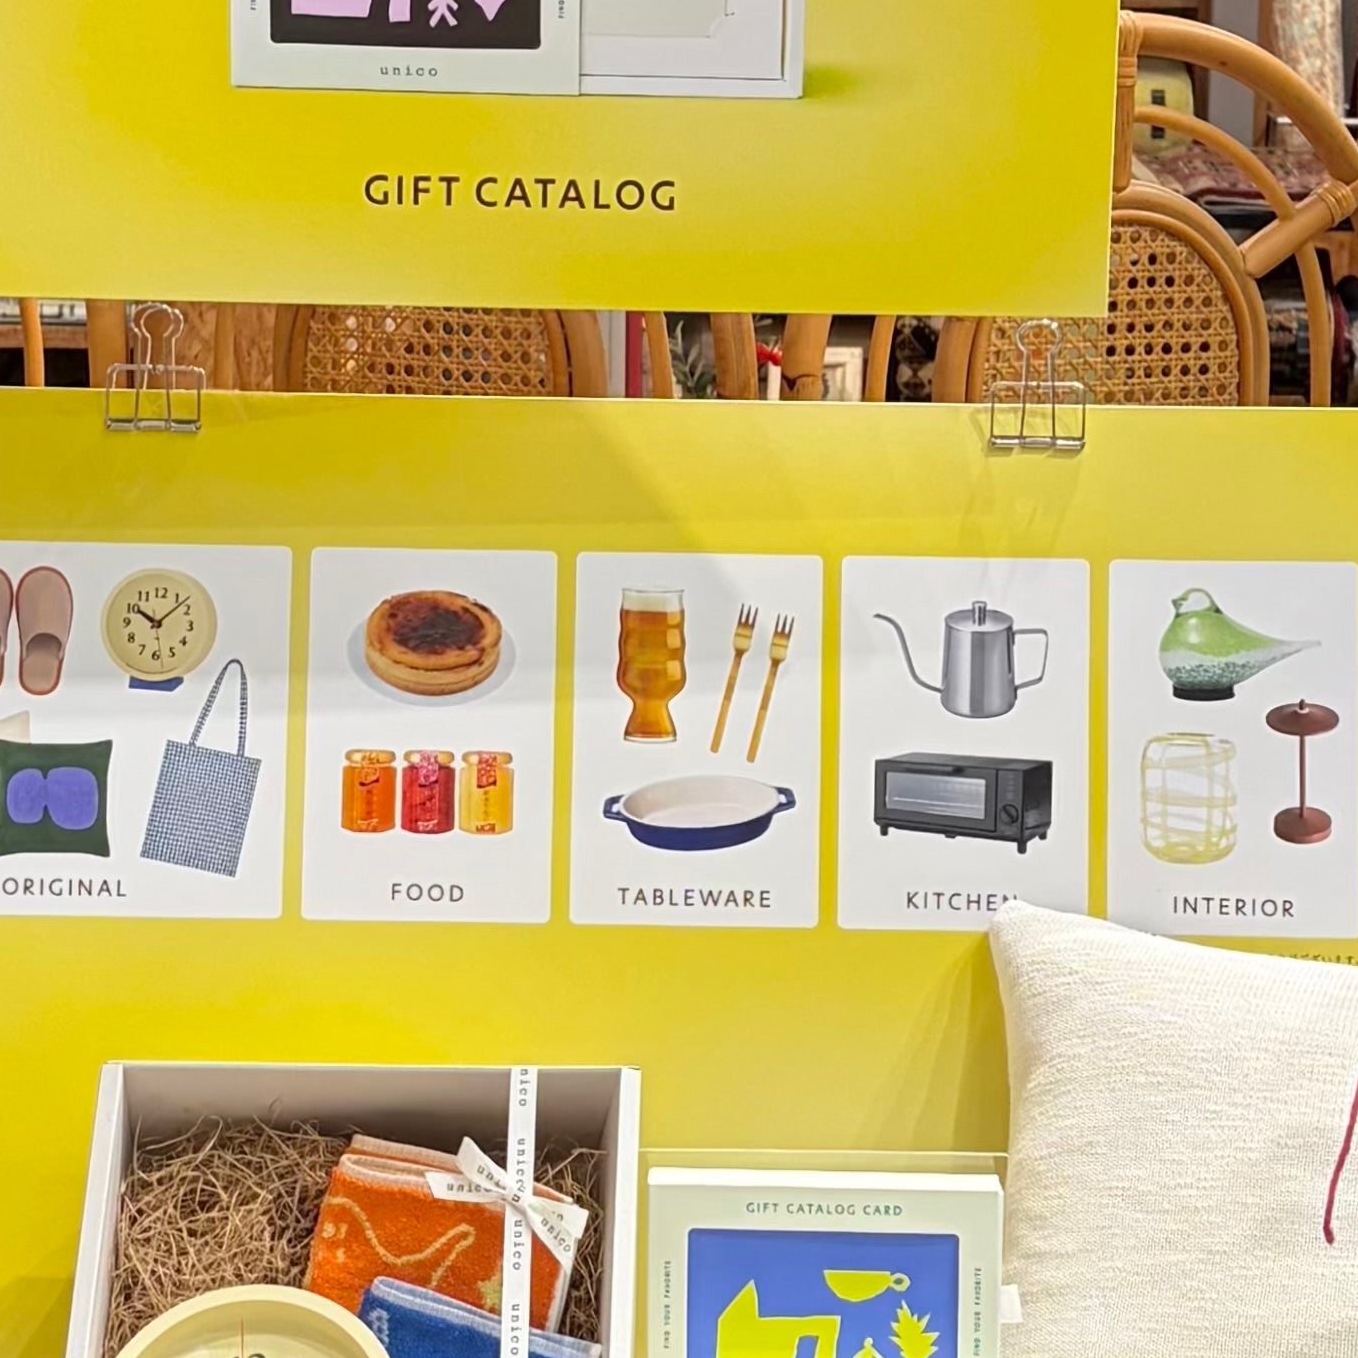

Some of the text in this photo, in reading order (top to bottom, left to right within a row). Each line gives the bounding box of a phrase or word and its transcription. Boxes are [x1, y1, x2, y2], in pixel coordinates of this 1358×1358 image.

[380, 64, 439, 78] unico
[364, 174, 676, 212] GIFT CATALOG
[137, 590, 150, 602] 11
[154, 587, 168, 599] 12
[175, 593, 180, 603] 1
[127, 603, 141, 614] 10
[183, 604, 191, 616] 2
[123, 617, 131, 628] 9
[186, 620, 194, 632] 3
[127, 632, 136, 643] 8
[179, 636, 188, 646] 4
[138, 644, 146, 656] 7
[151, 650, 160, 661] 6
[168, 646, 176, 658] 5
[2, 877, 128, 898] ORIGINAL
[391, 882, 465, 903] FOOD
[618, 887, 772, 909] TABLEWARE
[1173, 895, 1295, 918] INTERIOR
[745, 1201, 903, 1217] GIFT CATALOG CARD
[540, 1217, 572, 1254] unico
[512, 1219, 525, 1271] unico
[510, 1303, 523, 1357] unico
